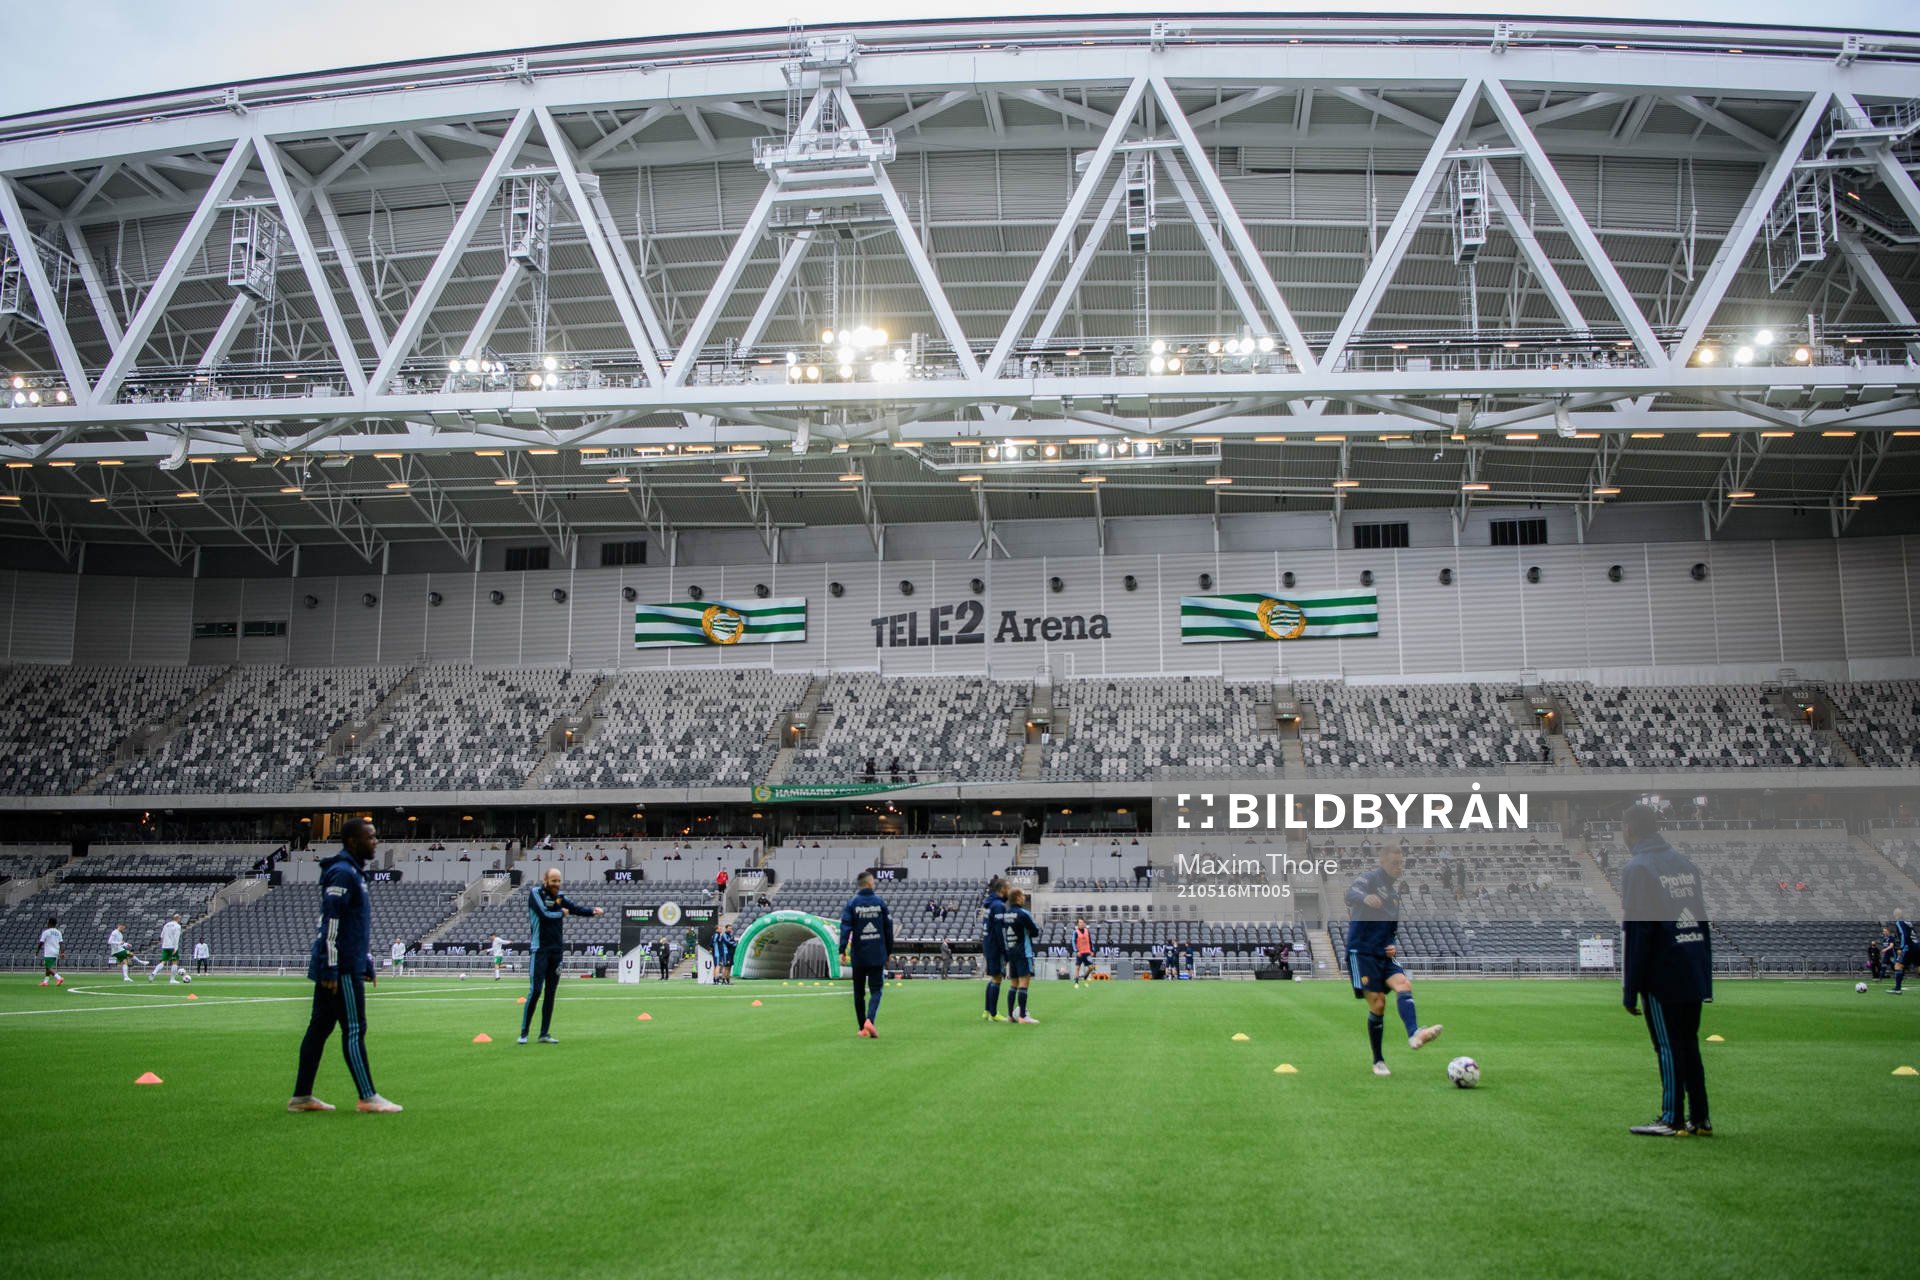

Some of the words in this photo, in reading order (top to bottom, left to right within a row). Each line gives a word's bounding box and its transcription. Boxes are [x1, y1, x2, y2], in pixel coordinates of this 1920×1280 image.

[871, 600, 985, 648] TELE2
[993, 610, 1112, 644] Arena
[775, 788, 837, 798] HAMMARBY
[374, 872, 391, 881] LIVE
[615, 871, 632, 880] LIVE
[876, 870, 895, 879] LIVE
[1146, 869, 1165, 878] LIVE
[626, 909, 654, 917] UNIBET
[685, 909, 714, 917] UNIBET
[626, 960, 633, 970] U
[705, 960, 712, 970] U
